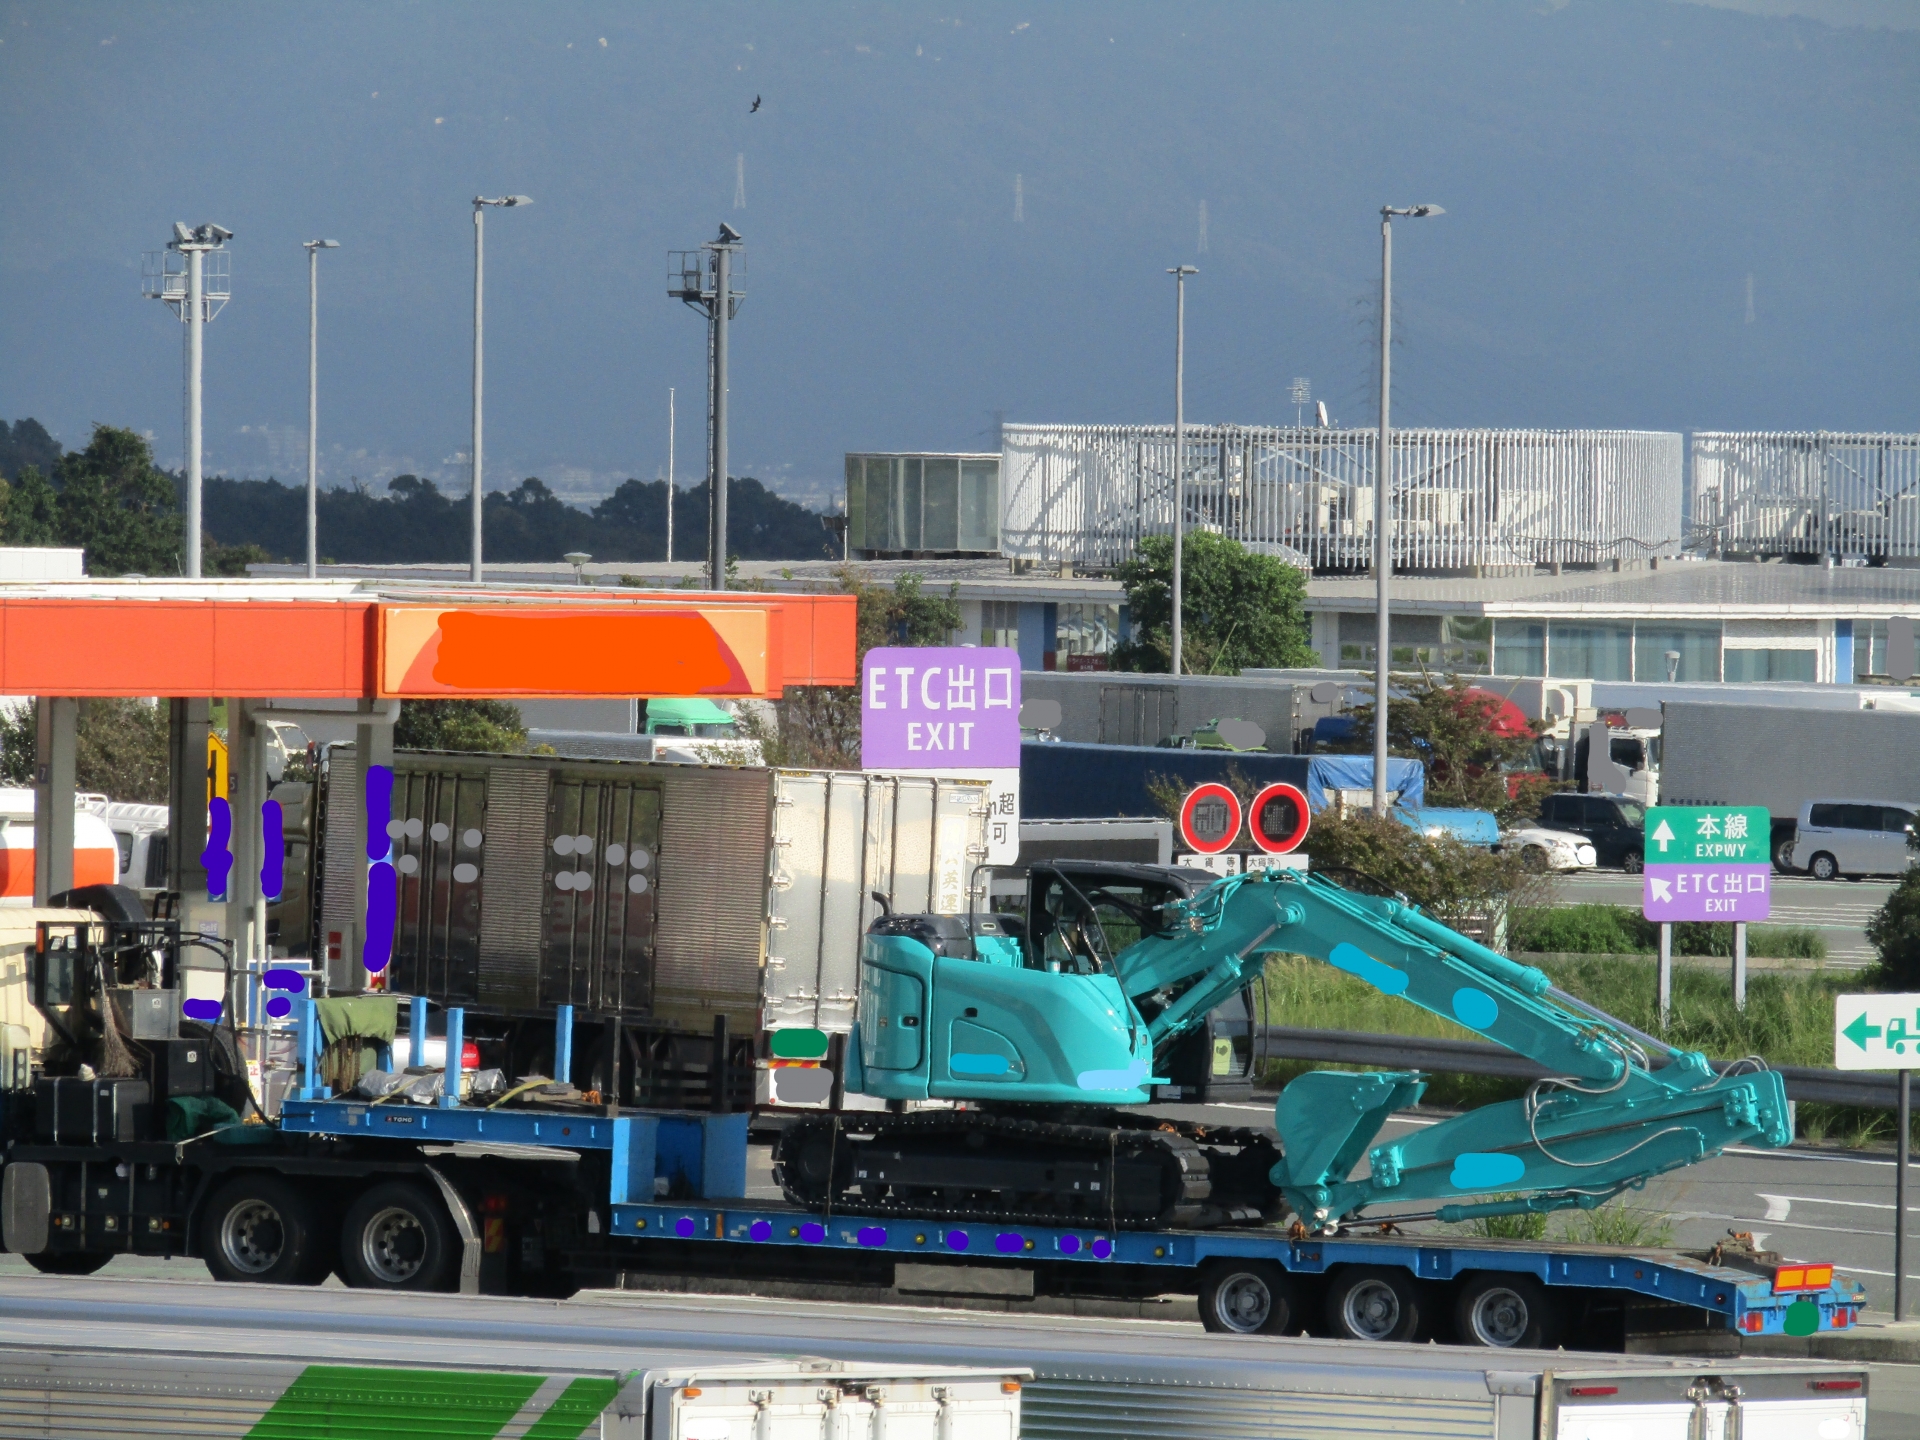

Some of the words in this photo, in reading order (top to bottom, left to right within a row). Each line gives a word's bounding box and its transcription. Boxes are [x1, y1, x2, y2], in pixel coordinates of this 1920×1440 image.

[869, 664, 1012, 711] ETC出口
[907, 722, 975, 751] EXIT
[1696, 813, 1749, 840] 本線
[1695, 843, 1747, 858] EXPWY
[1676, 872, 1766, 894] ETC出口
[1705, 898, 1738, 912] EXIT
[199, 922, 217, 932] Self
